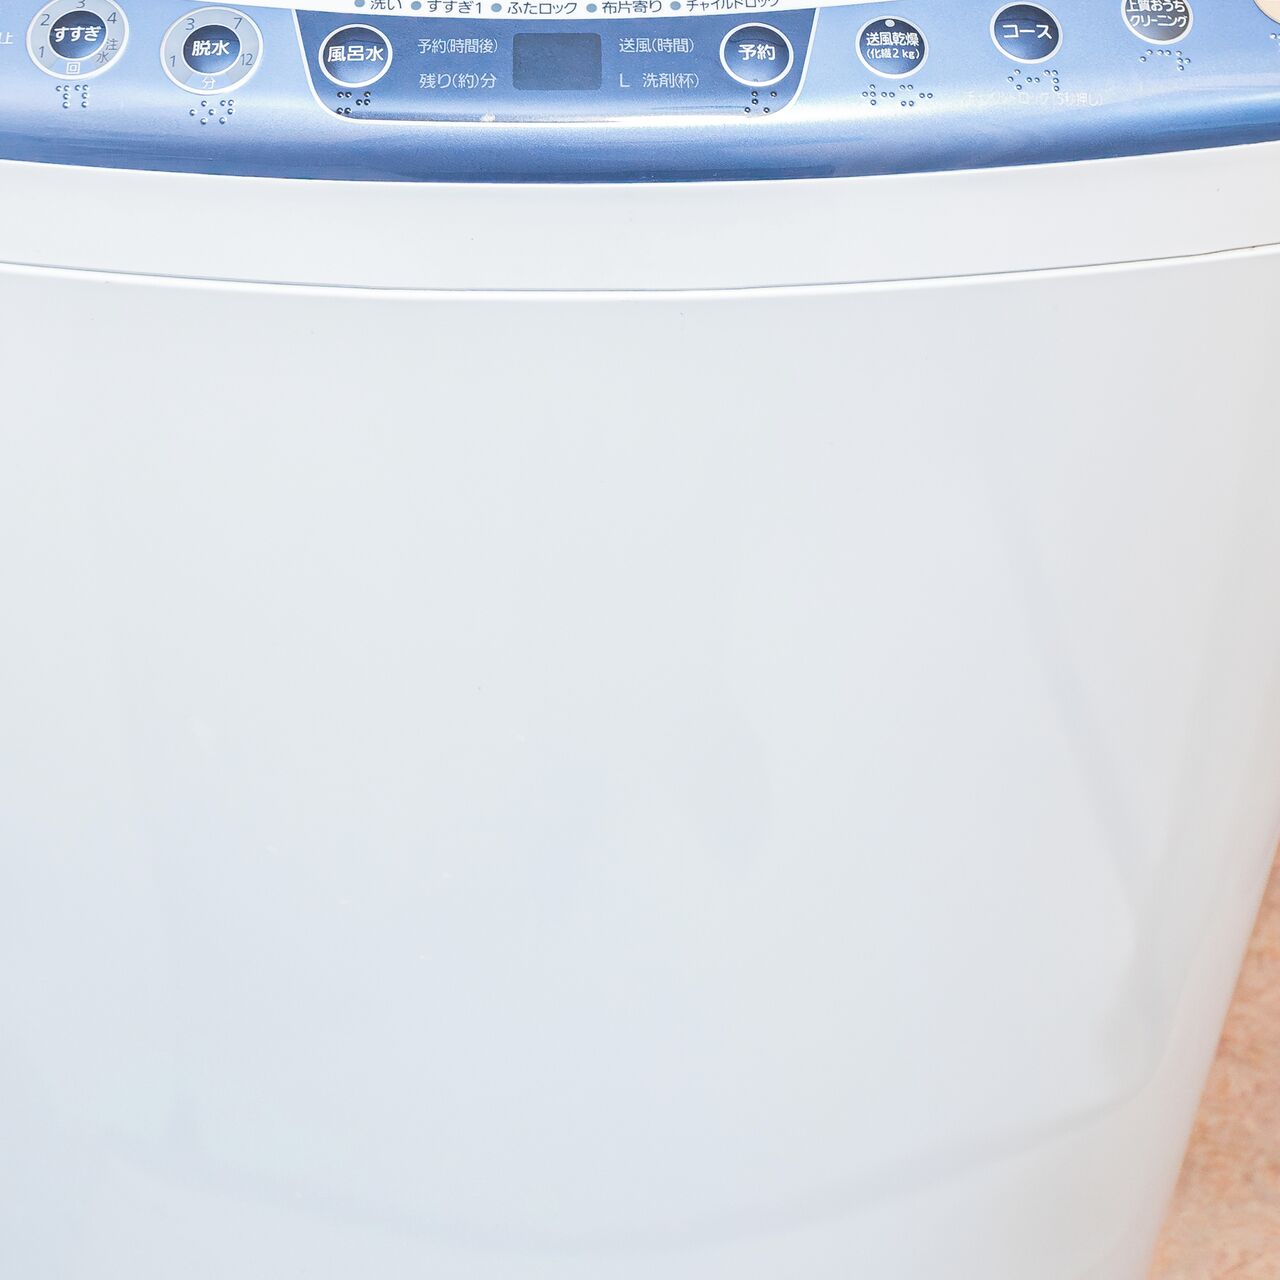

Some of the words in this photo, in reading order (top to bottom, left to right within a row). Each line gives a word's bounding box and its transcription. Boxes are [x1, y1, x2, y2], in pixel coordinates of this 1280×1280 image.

[427, 0, 482, 15] すすぎ1
[507, 1, 578, 16] ふたロック
[601, 0, 663, 14] 布片寄り
[40, 13, 51, 26] 2
[106, 11, 118, 24] 4
[185, 17, 195, 31] 3
[233, 17, 243, 29] 7
[1129, 14, 1188, 28] クリーニング
[54, 25, 102, 43] すすぎ
[1002, 23, 1053, 40] コース
[865, 31, 920, 47] 送風乾燥
[38, 45, 46, 58] 1
[191, 39, 231, 57] 脱水
[327, 45, 384, 63] 風呂水
[417, 38, 498, 55] 予約(時間後)
[618, 37, 695, 54] 送風(時間)
[738, 43, 776, 61] 予約
[169, 55, 177, 68] 1
[240, 52, 254, 66] 12
[201, 75, 217, 89] 分
[419, 72, 498, 89] 残り(約)分
[642, 72, 700, 89] 洗剤(杯)
